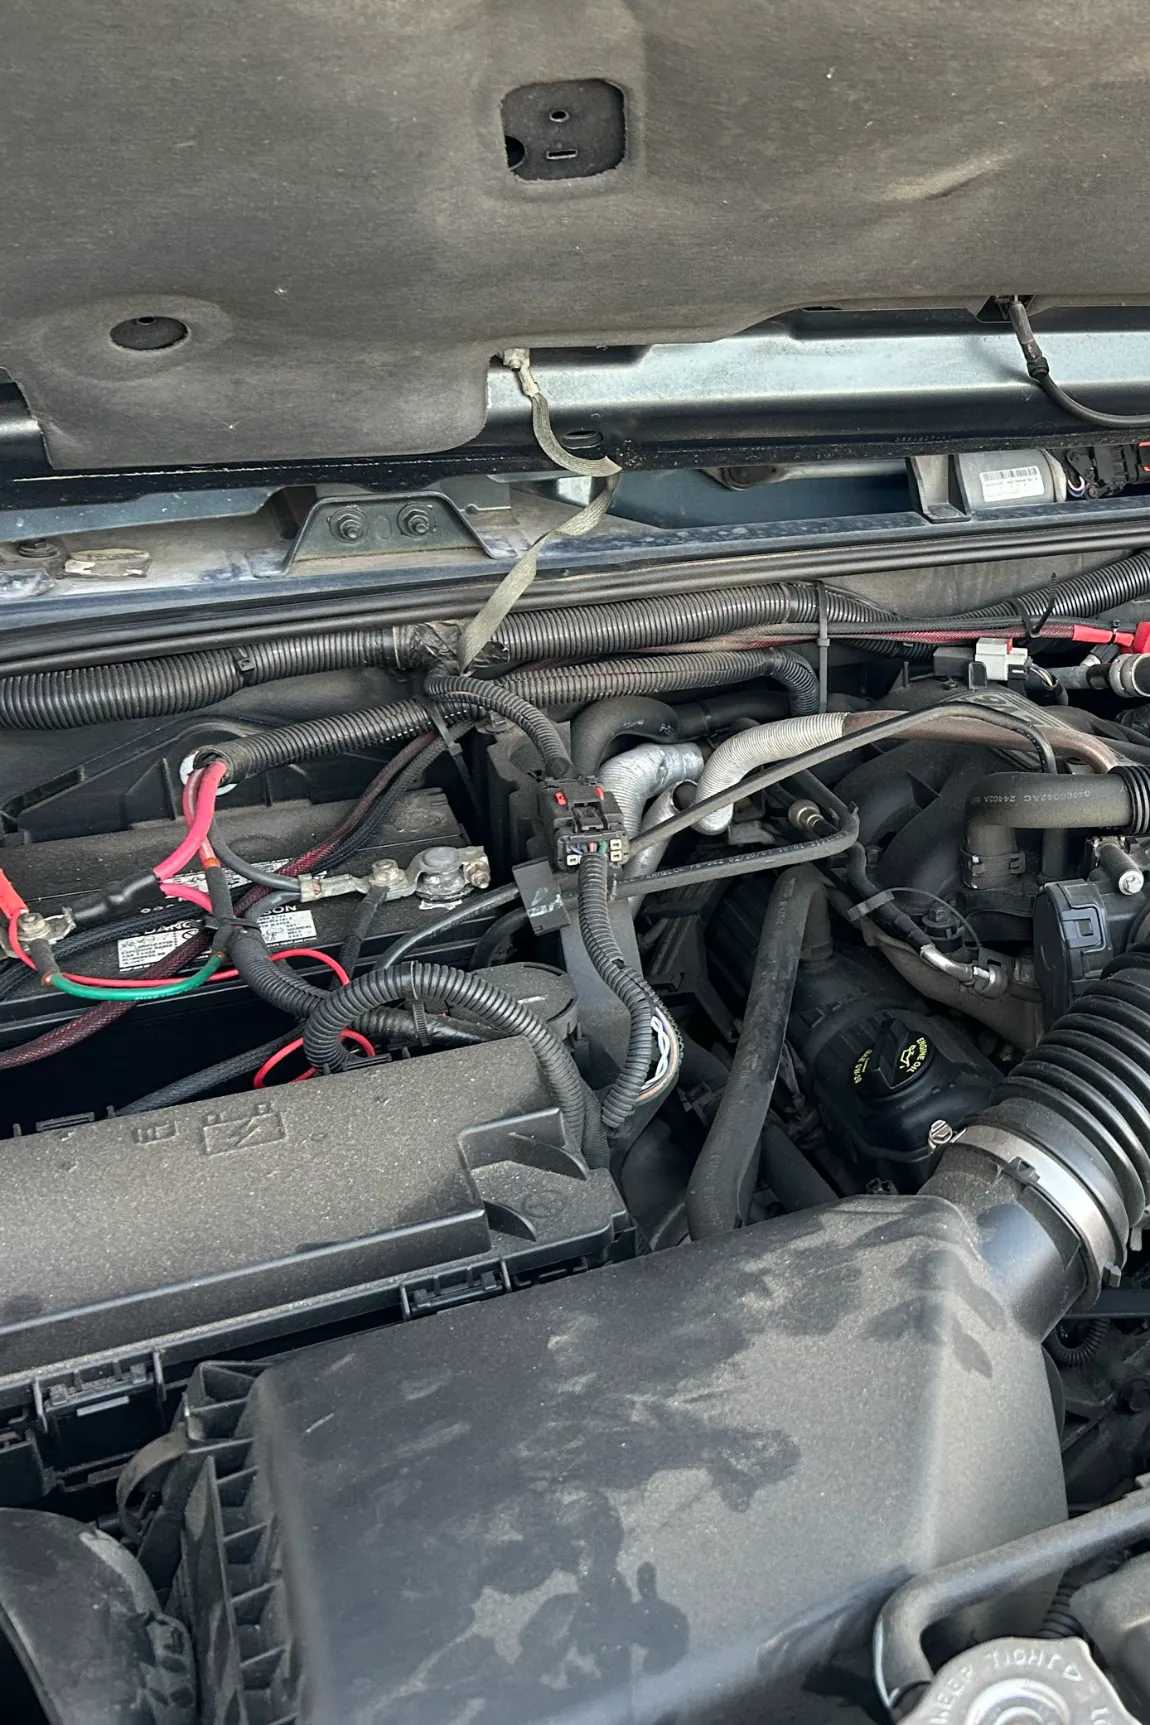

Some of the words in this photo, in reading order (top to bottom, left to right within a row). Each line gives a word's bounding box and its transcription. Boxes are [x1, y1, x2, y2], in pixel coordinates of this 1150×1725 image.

[915, 1036, 929, 1061] ENGINE
[906, 1061, 922, 1073] OIL
[985, 1647, 1062, 1669] TIGHT
